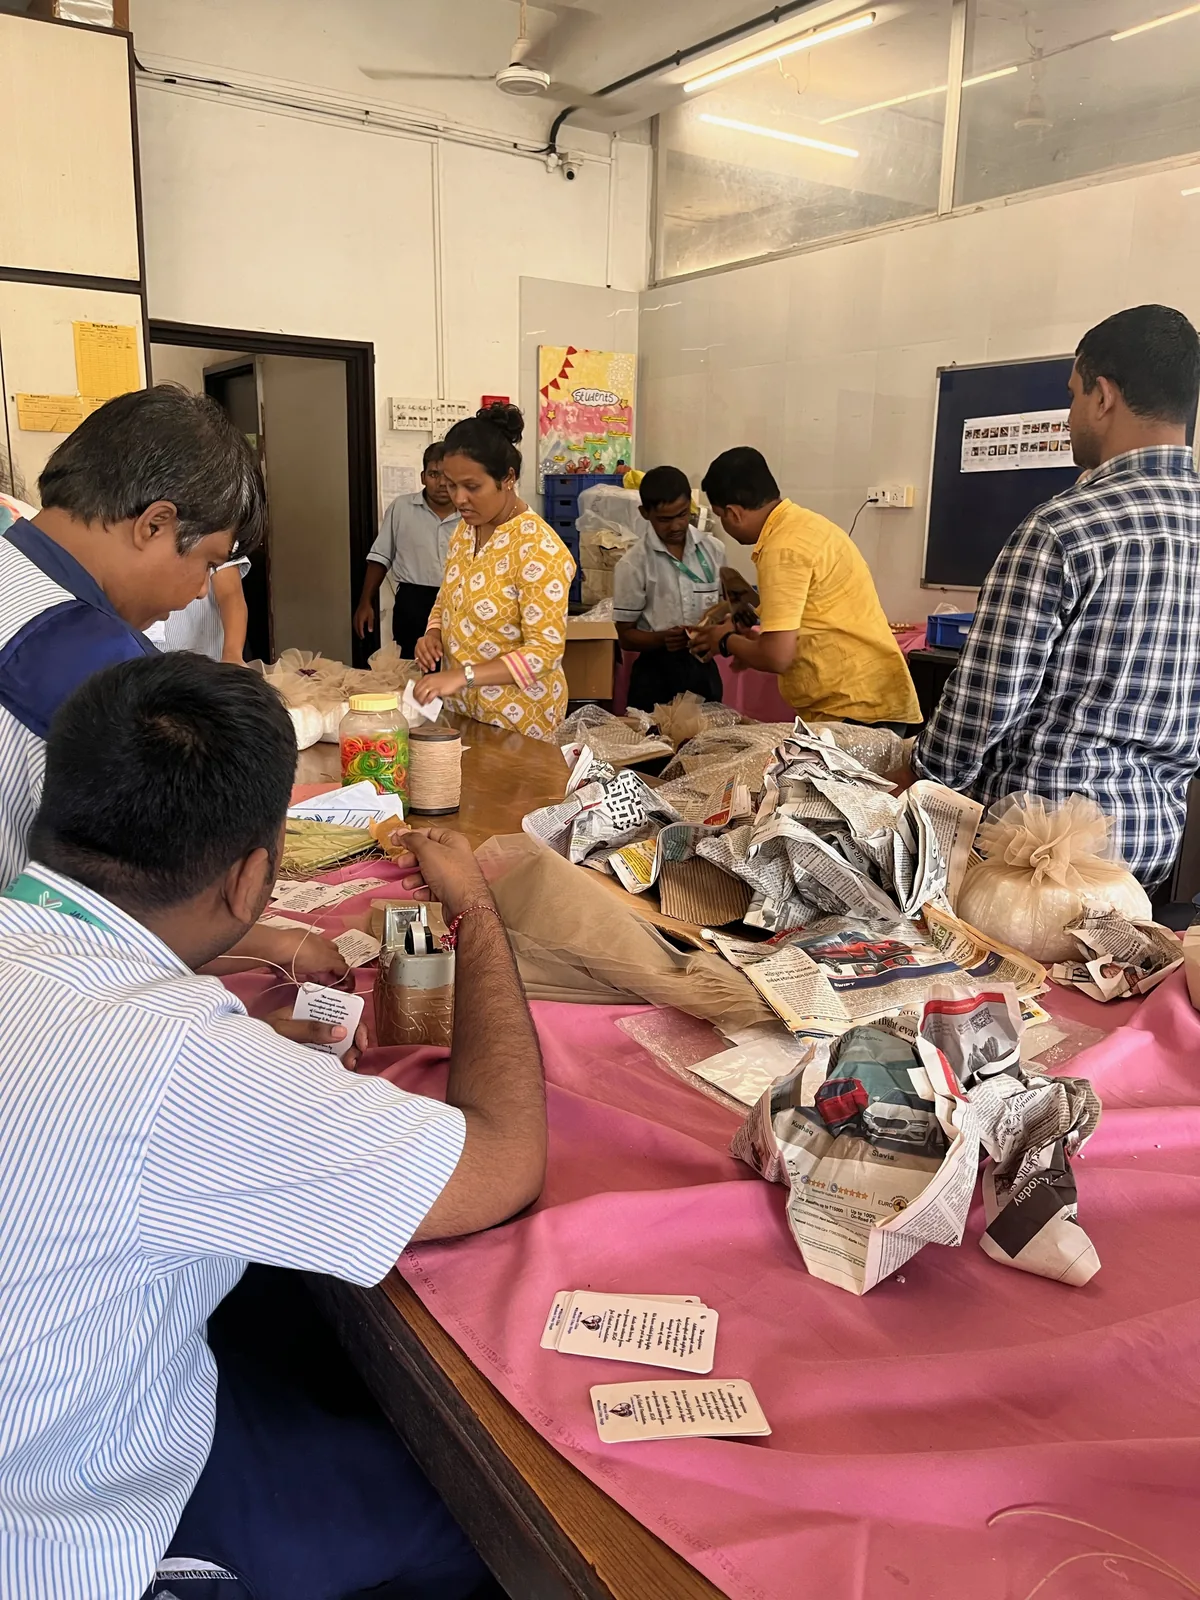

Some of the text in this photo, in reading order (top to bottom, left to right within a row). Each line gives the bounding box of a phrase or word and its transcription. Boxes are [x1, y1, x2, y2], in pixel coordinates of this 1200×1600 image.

[791, 1119, 814, 1137] Kushaq
[871, 1149, 895, 1161] Slavia
[1013, 1177, 1042, 1207] today
[878, 1200, 893, 1209] EURO
